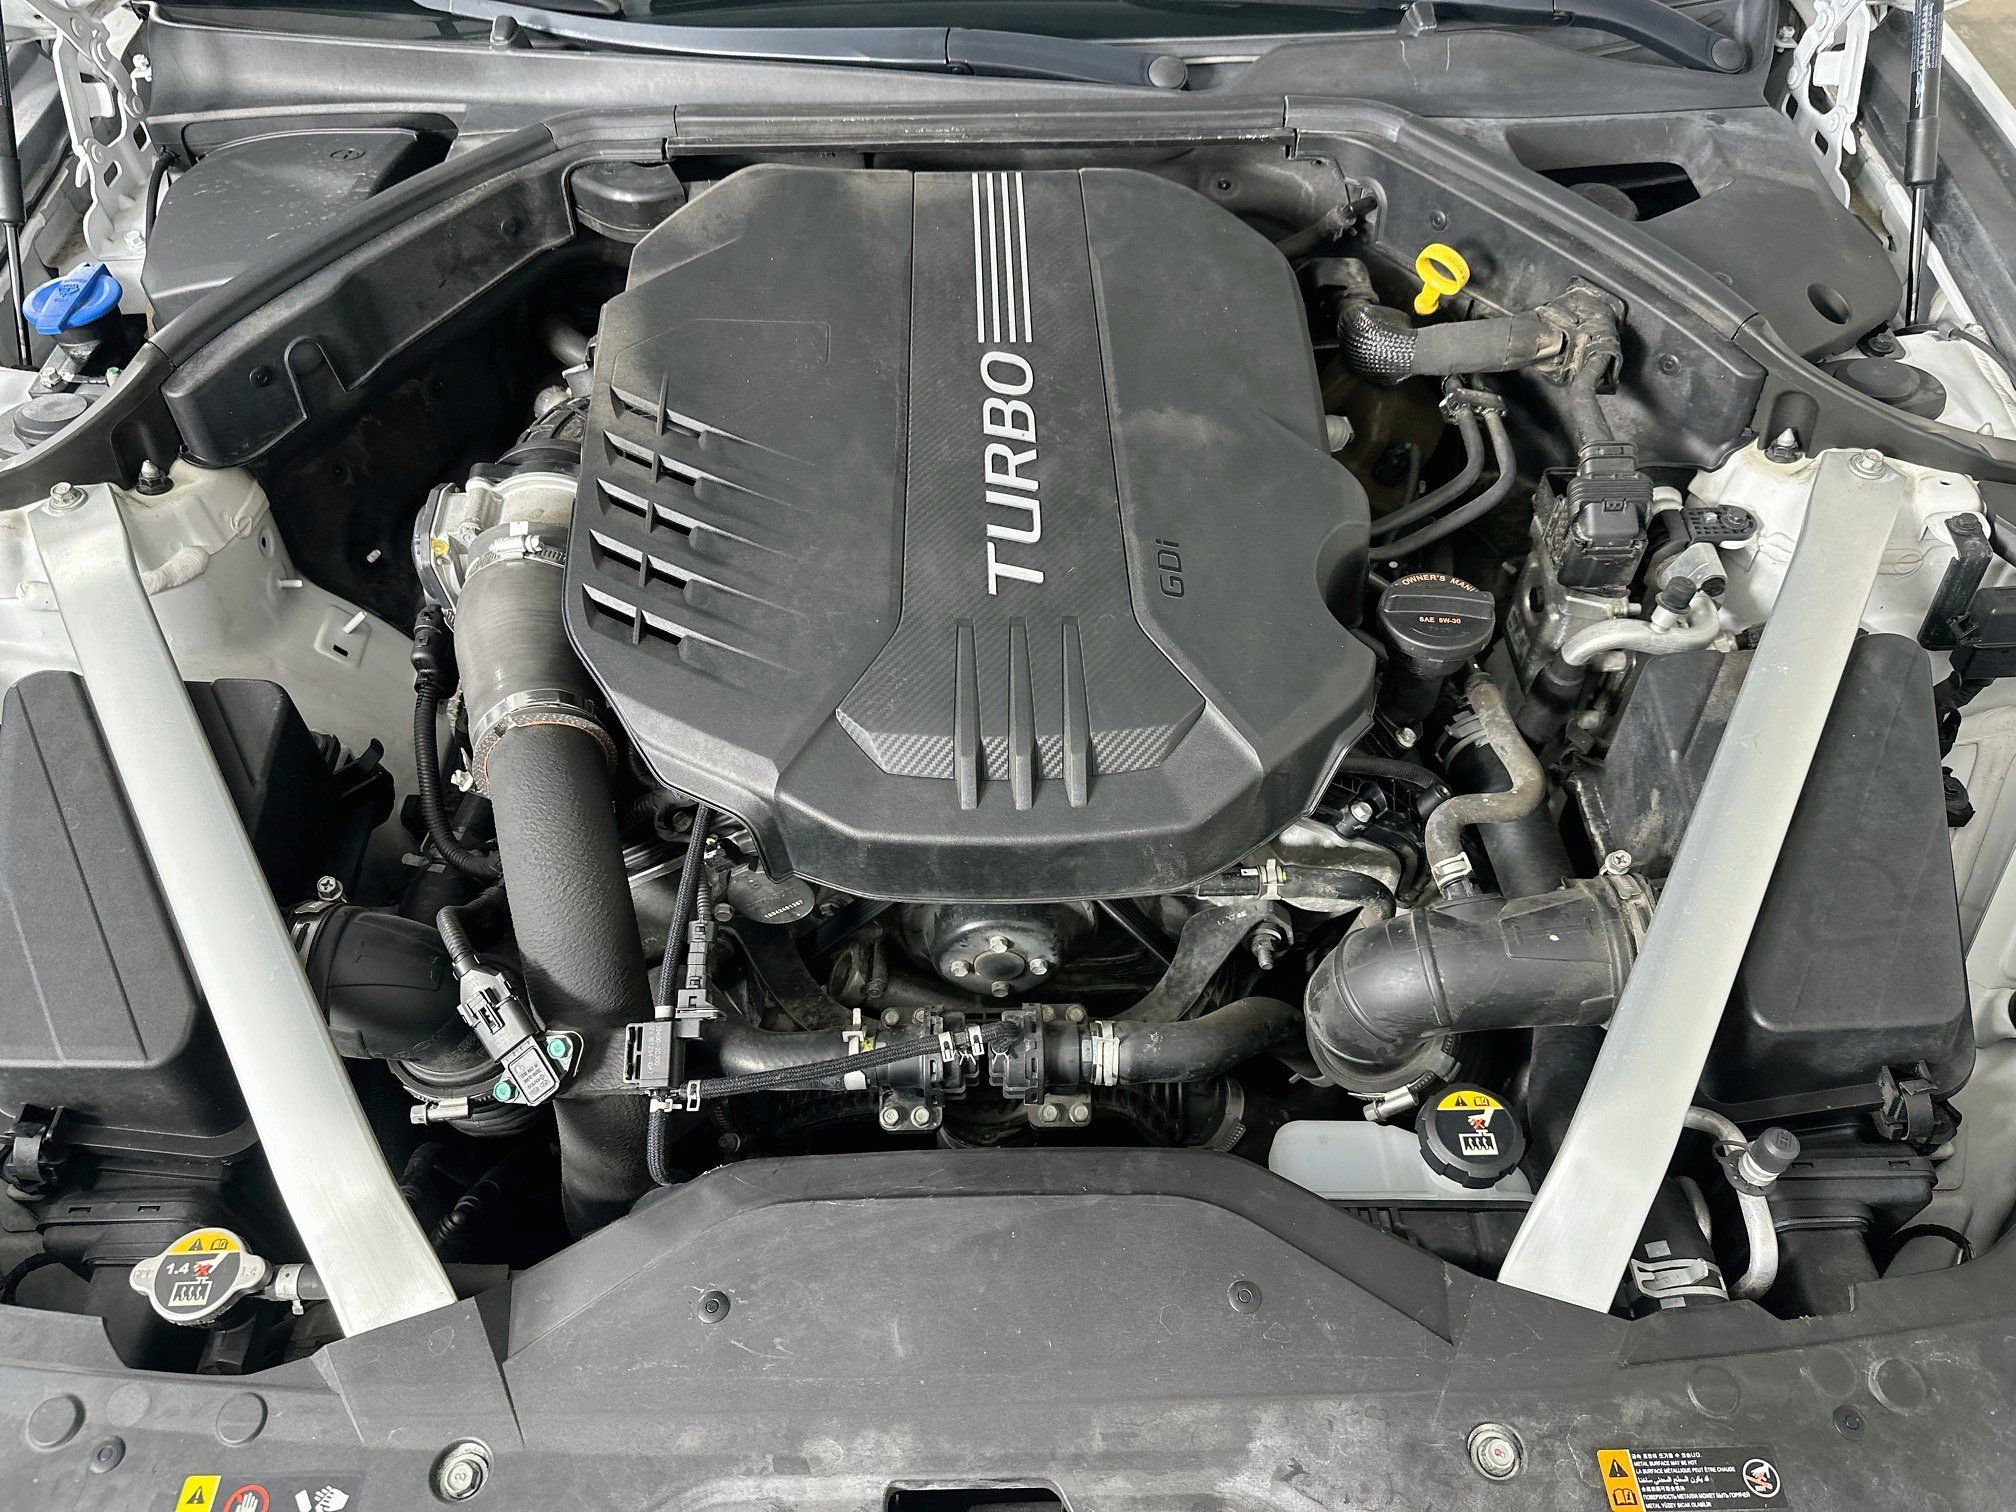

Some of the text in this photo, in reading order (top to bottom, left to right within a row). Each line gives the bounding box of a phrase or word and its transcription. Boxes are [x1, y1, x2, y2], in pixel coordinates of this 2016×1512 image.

[980, 351, 1044, 596] TURBO
[1155, 538, 1185, 598] GDi
[1402, 574, 1446, 586] OWNER'S
[1438, 617, 1462, 625] 5W-30
[166, 1262, 190, 1275] 1.4
